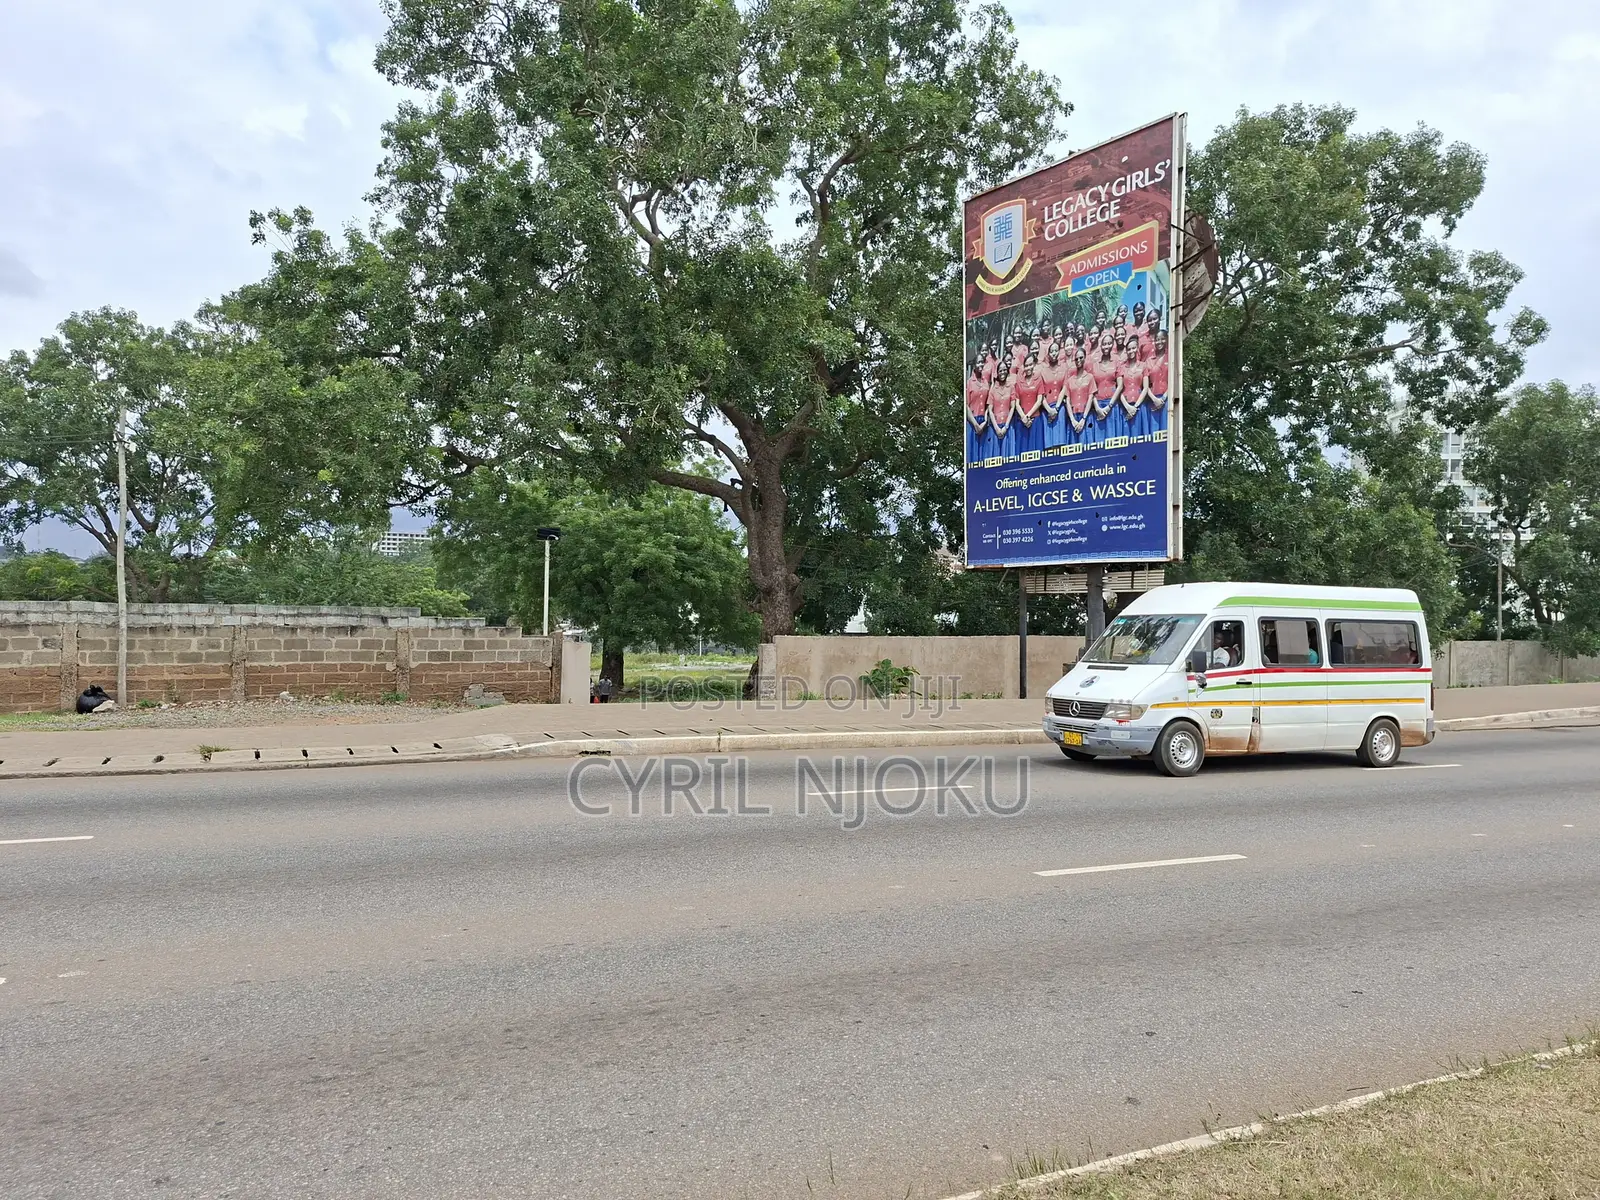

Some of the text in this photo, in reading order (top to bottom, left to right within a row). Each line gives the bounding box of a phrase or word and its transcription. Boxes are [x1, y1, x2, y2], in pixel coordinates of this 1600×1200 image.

[1044, 182, 1110, 223] LEGACY
[1044, 199, 1121, 242] COLLEGE
[1068, 240, 1148, 276] ADMISSIONS
[1084, 268, 1120, 288] OPEN
[996, 463, 1126, 490] Offering enhanced curricula in
[973, 480, 1156, 513] A-LEVEL, IGCSE & WASSCE
